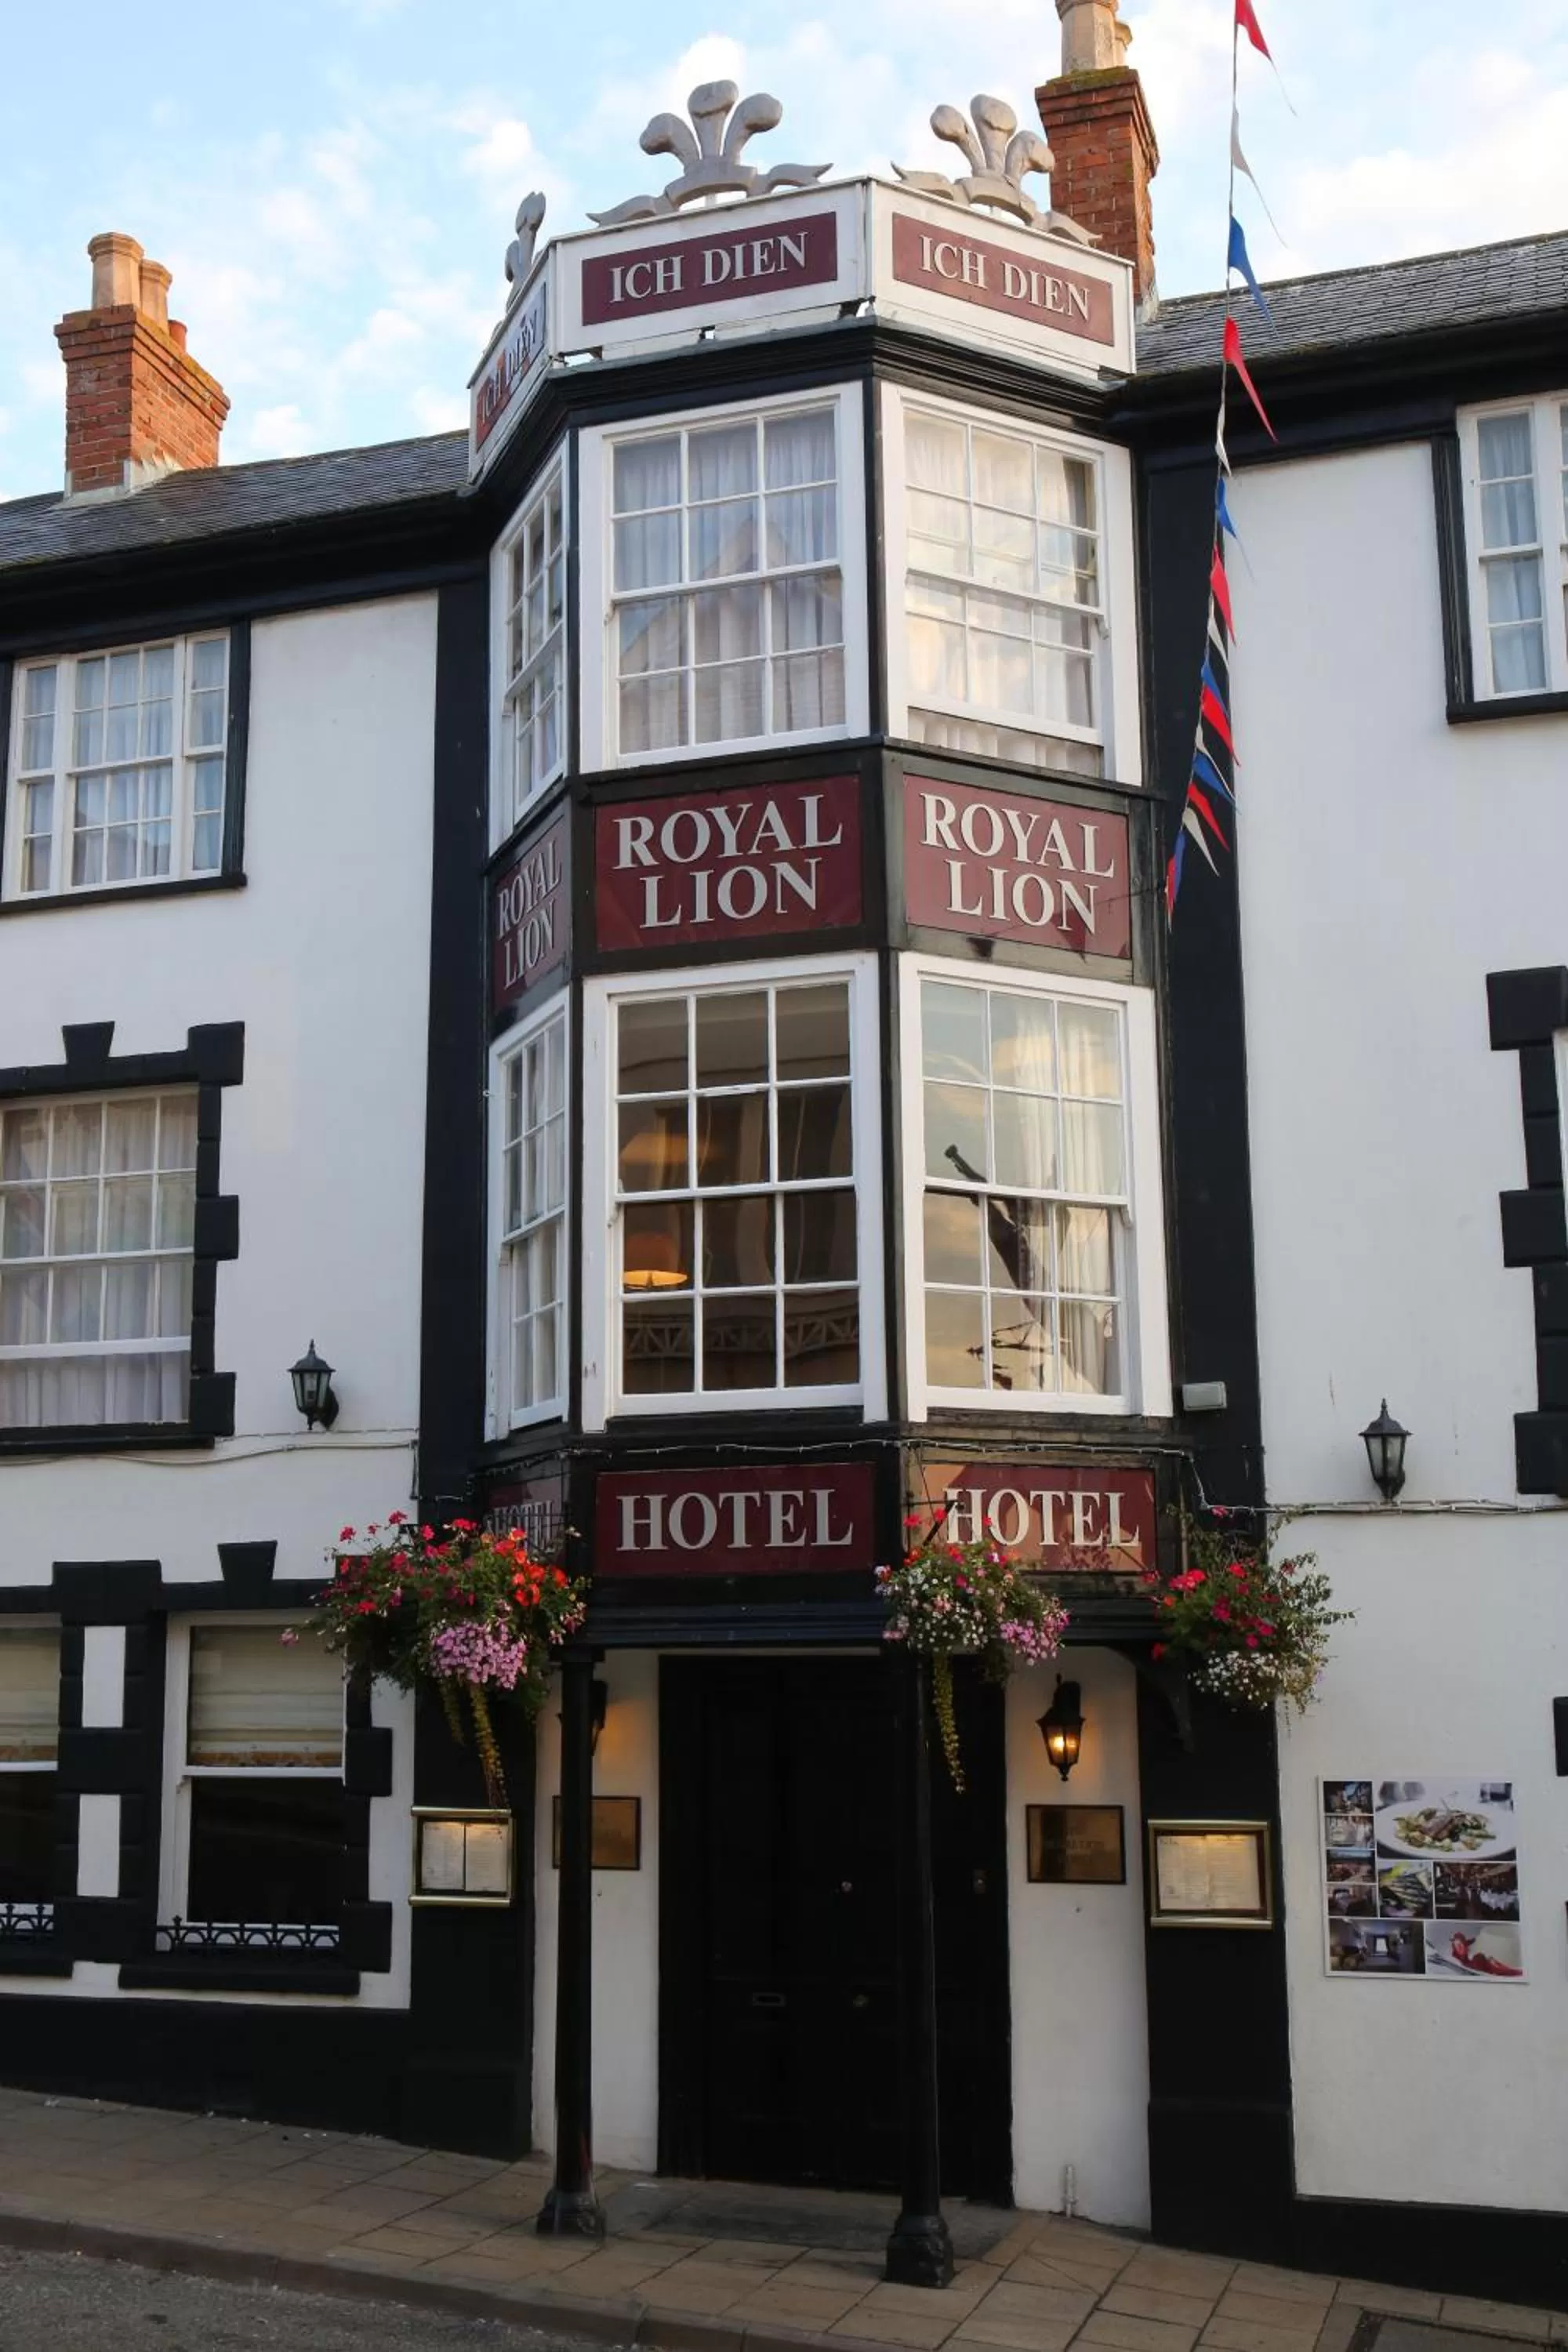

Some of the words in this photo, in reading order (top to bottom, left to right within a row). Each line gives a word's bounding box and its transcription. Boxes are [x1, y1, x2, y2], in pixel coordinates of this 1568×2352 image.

[609, 255, 684, 303] ICH
[701, 231, 808, 287] DIEN
[919, 234, 988, 290] ICH
[1001, 260, 1091, 321] DIEN
[612, 794, 844, 870] ROYAL
[919, 792, 1114, 878] ROYAL
[498, 839, 562, 940] ROYAL
[640, 857, 822, 929] LION
[946, 858, 1098, 935] LION
[503, 898, 555, 990] LION
[616, 1489, 854, 1552] HOTEL
[942, 1488, 1139, 1547] HOTEL
